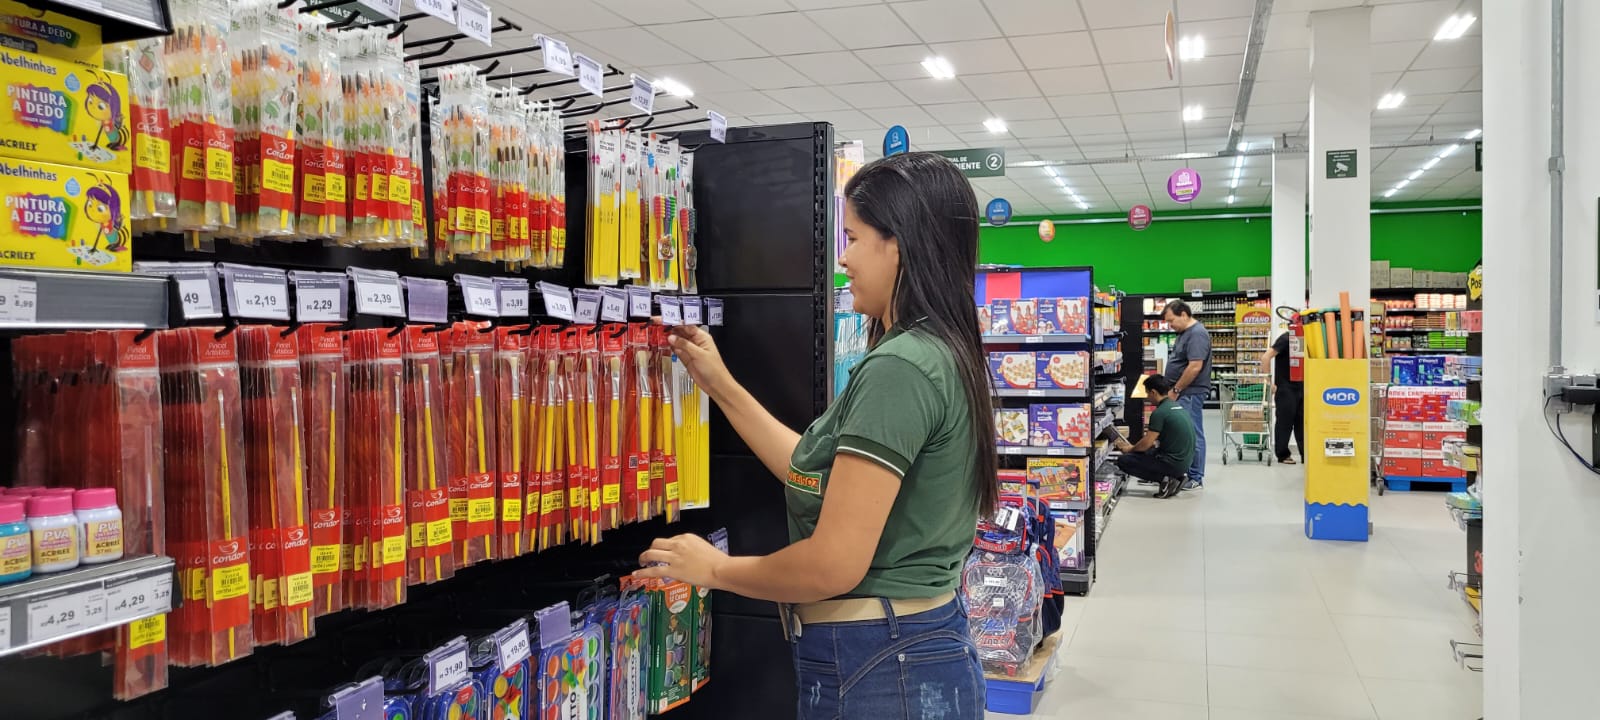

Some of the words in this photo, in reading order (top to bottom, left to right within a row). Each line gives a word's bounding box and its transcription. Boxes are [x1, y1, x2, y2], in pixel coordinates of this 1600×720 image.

[48, 26, 72, 40] DEDO
[7, 84, 67, 108] PINTURA
[13, 98, 22, 111] A
[24, 101, 64, 119] DEDO
[266, 147, 294, 161] Condor
[990, 157, 998, 167] 2
[5, 194, 67, 213] PINTURA
[11, 210, 20, 223] A
[23, 210, 63, 226] DEDO
[254, 295, 277, 307] 2,19
[373, 293, 392, 305] 2,39
[313, 300, 332, 312] 2,29
[127, 345, 147, 354] Pincel
[208, 342, 227, 351] Pincel
[1326, 392, 1356, 401] MOR
[470, 480, 494, 490] Condor
[426, 497, 448, 508] Condor
[313, 518, 340, 529] Condor
[383, 515, 404, 525] Condor
[44, 530, 70, 541] PVA
[285, 537, 309, 550] Condor
[212, 551, 246, 565] Condor
[120, 594, 145, 611] 4,29
[47, 610, 75, 625] 4,29
[510, 639, 526, 655] 19,90
[444, 660, 463, 676] 31,90
